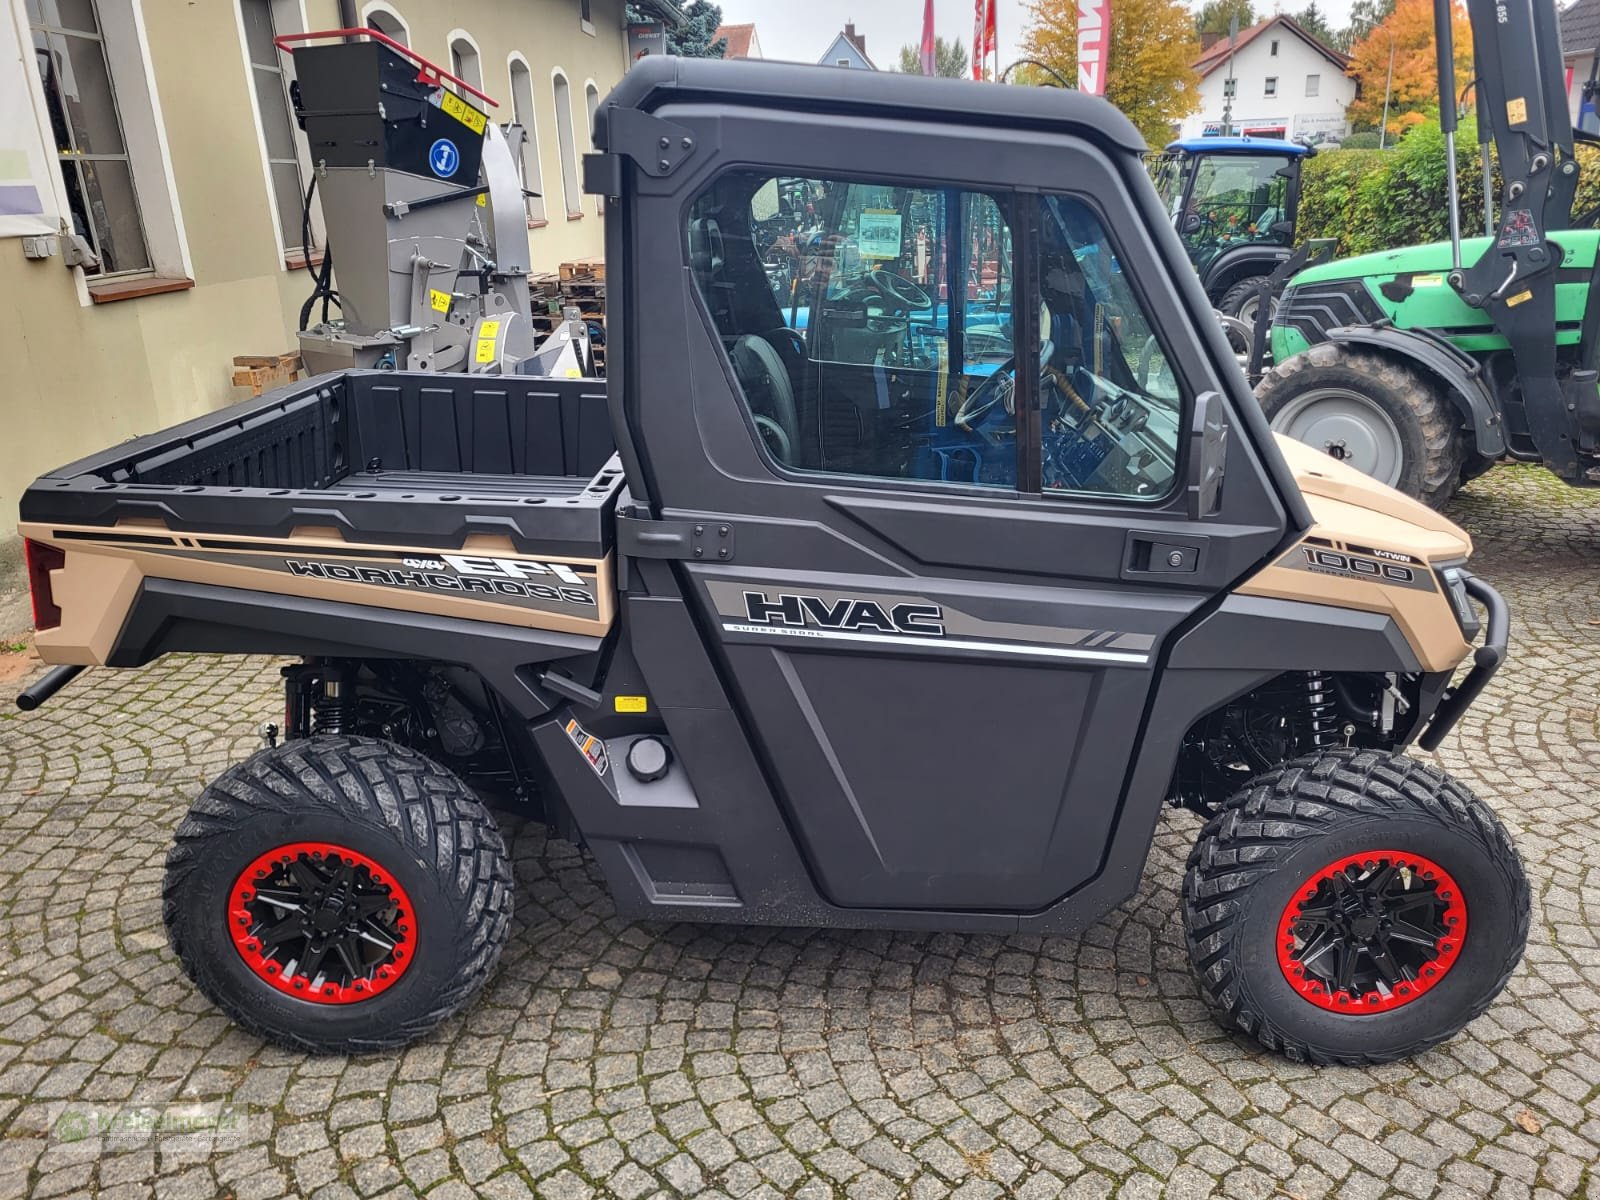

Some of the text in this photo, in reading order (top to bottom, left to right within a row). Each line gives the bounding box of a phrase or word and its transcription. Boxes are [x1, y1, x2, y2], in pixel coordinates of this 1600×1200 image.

[1496, 5, 1508, 23] 855
[439, 554, 589, 585] EFI
[1302, 546, 1414, 583] 1000
[1373, 549, 1411, 562] V-TWIN
[286, 559, 597, 606] WORKCROSS
[742, 590, 945, 637] HVAC
